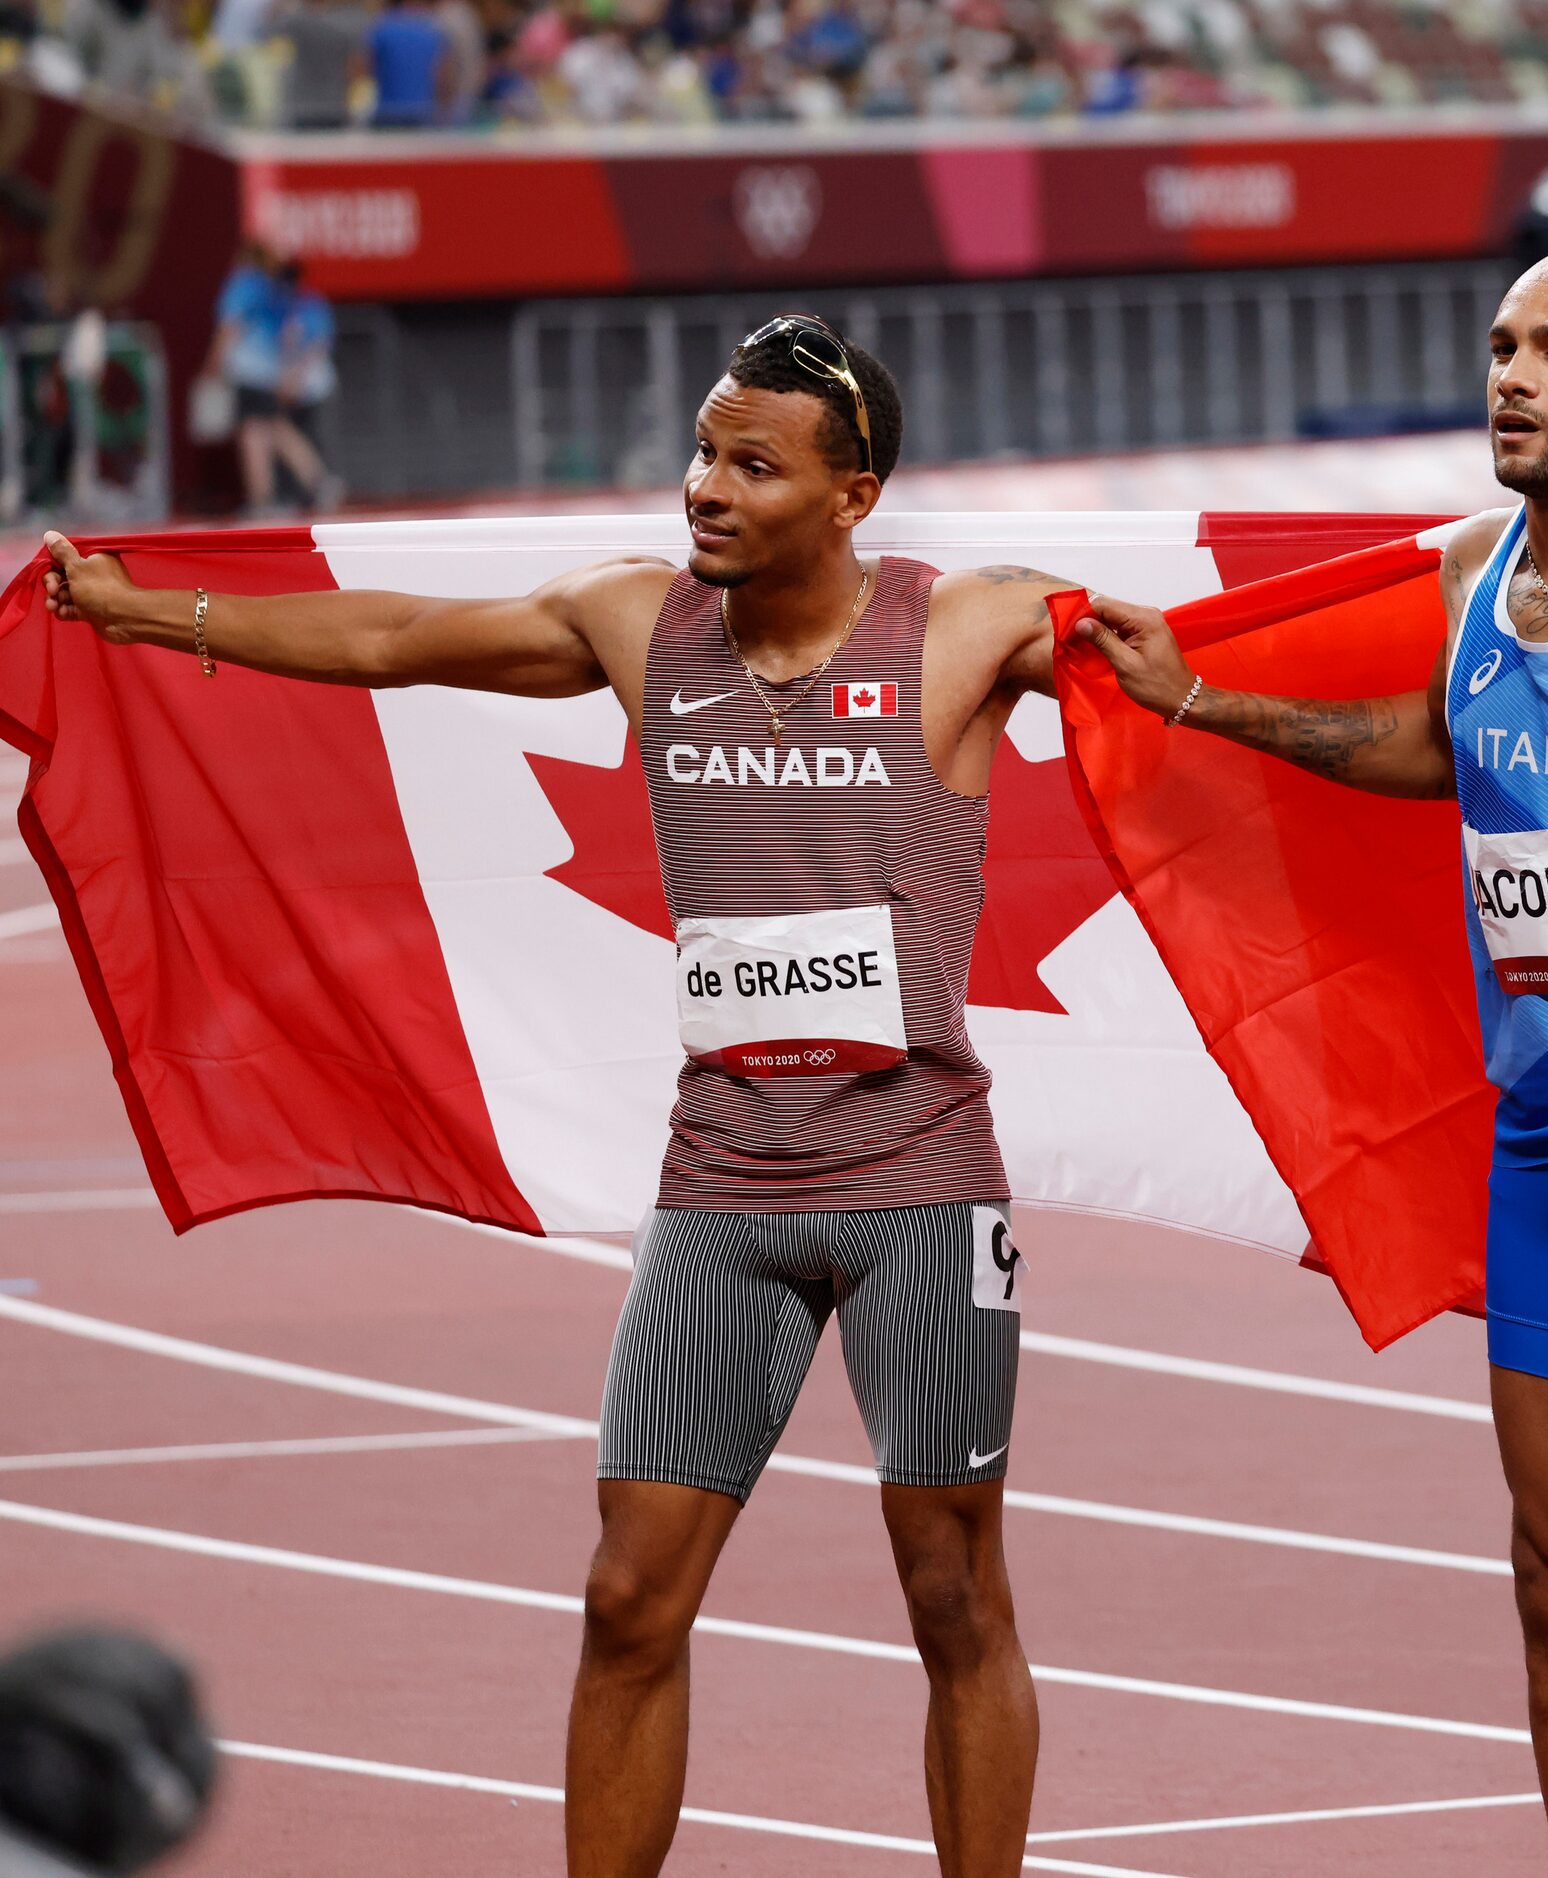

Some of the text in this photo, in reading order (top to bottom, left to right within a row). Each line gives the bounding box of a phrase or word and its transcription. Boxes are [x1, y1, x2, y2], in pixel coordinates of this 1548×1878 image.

[665, 744, 892, 786] CANADA
[686, 950, 882, 997] de GRASSE
[1504, 971, 1529, 982] TOKYO
[742, 1054, 800, 1066] TOKYO 2020
